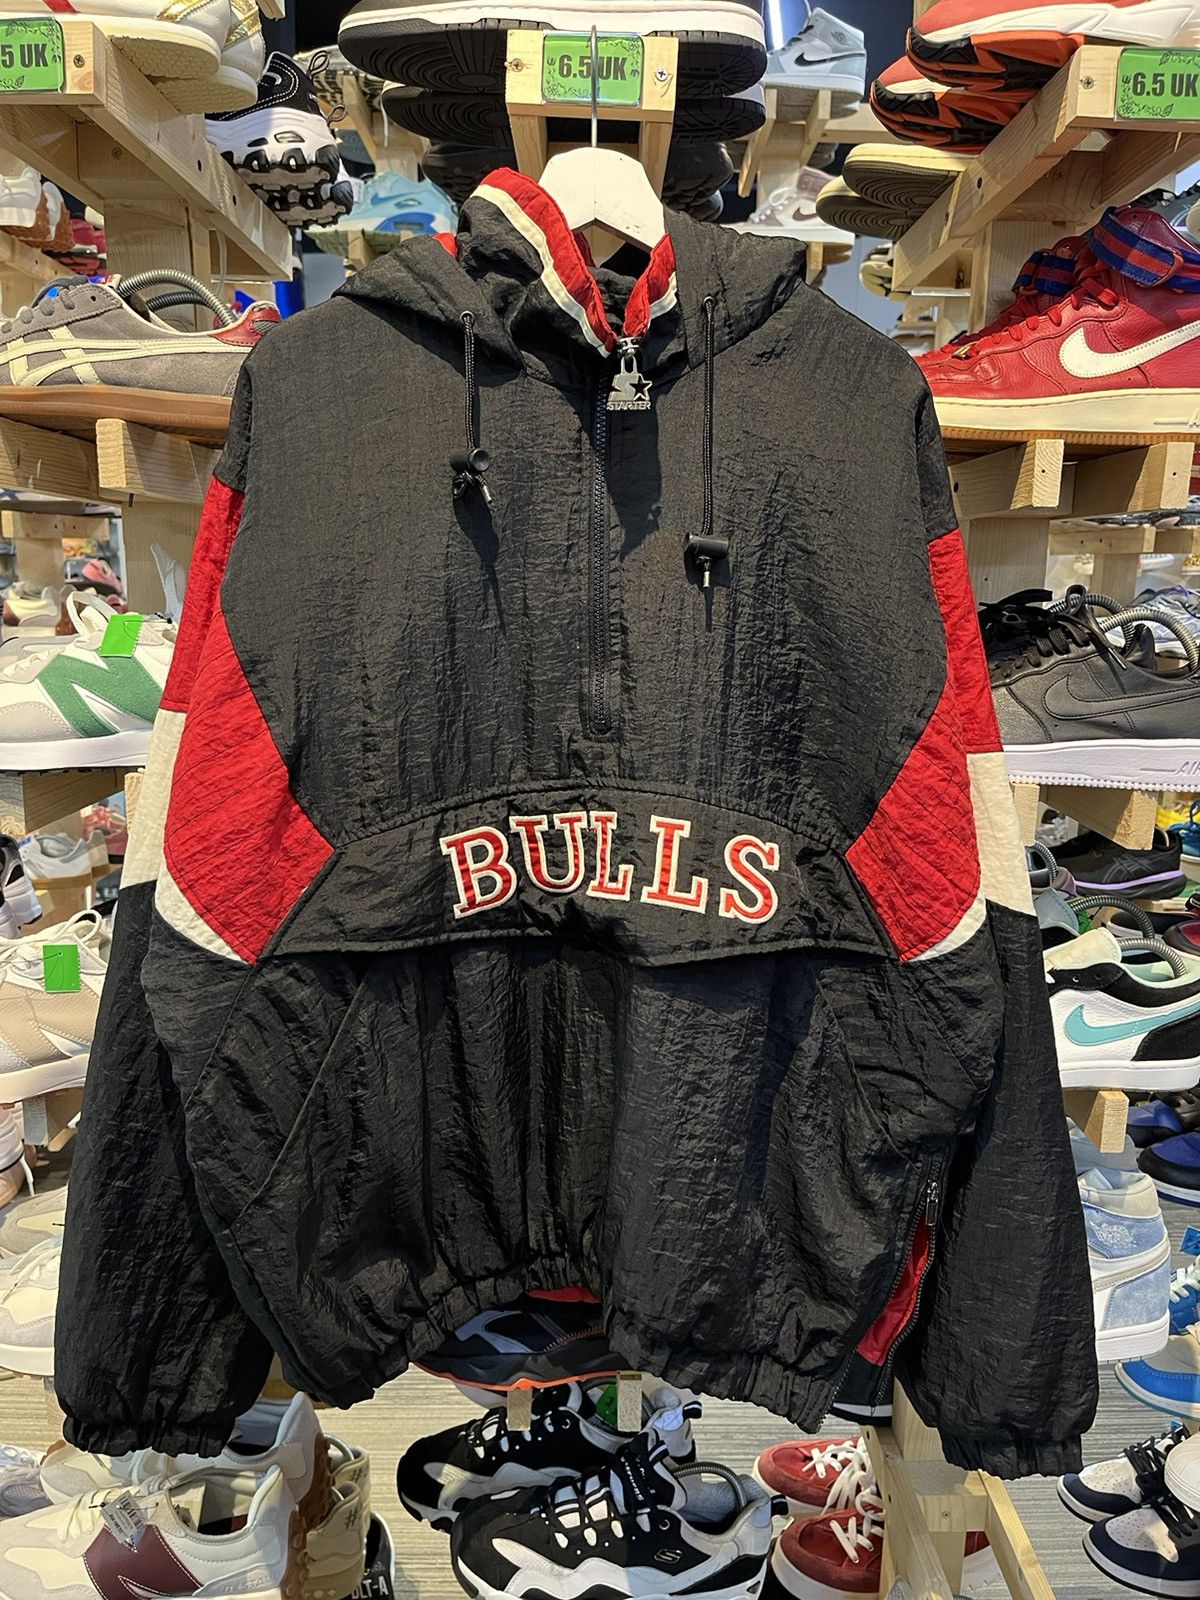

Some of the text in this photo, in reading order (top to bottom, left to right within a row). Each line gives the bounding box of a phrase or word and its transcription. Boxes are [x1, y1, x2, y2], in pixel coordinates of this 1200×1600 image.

[20, 43, 49, 69] UK
[559, 54, 628, 80] 6.5 UK
[1132, 71, 1199, 97] 6.5 UK
[606, 401, 651, 410] STARTER
[439, 811, 780, 924] BULLS
